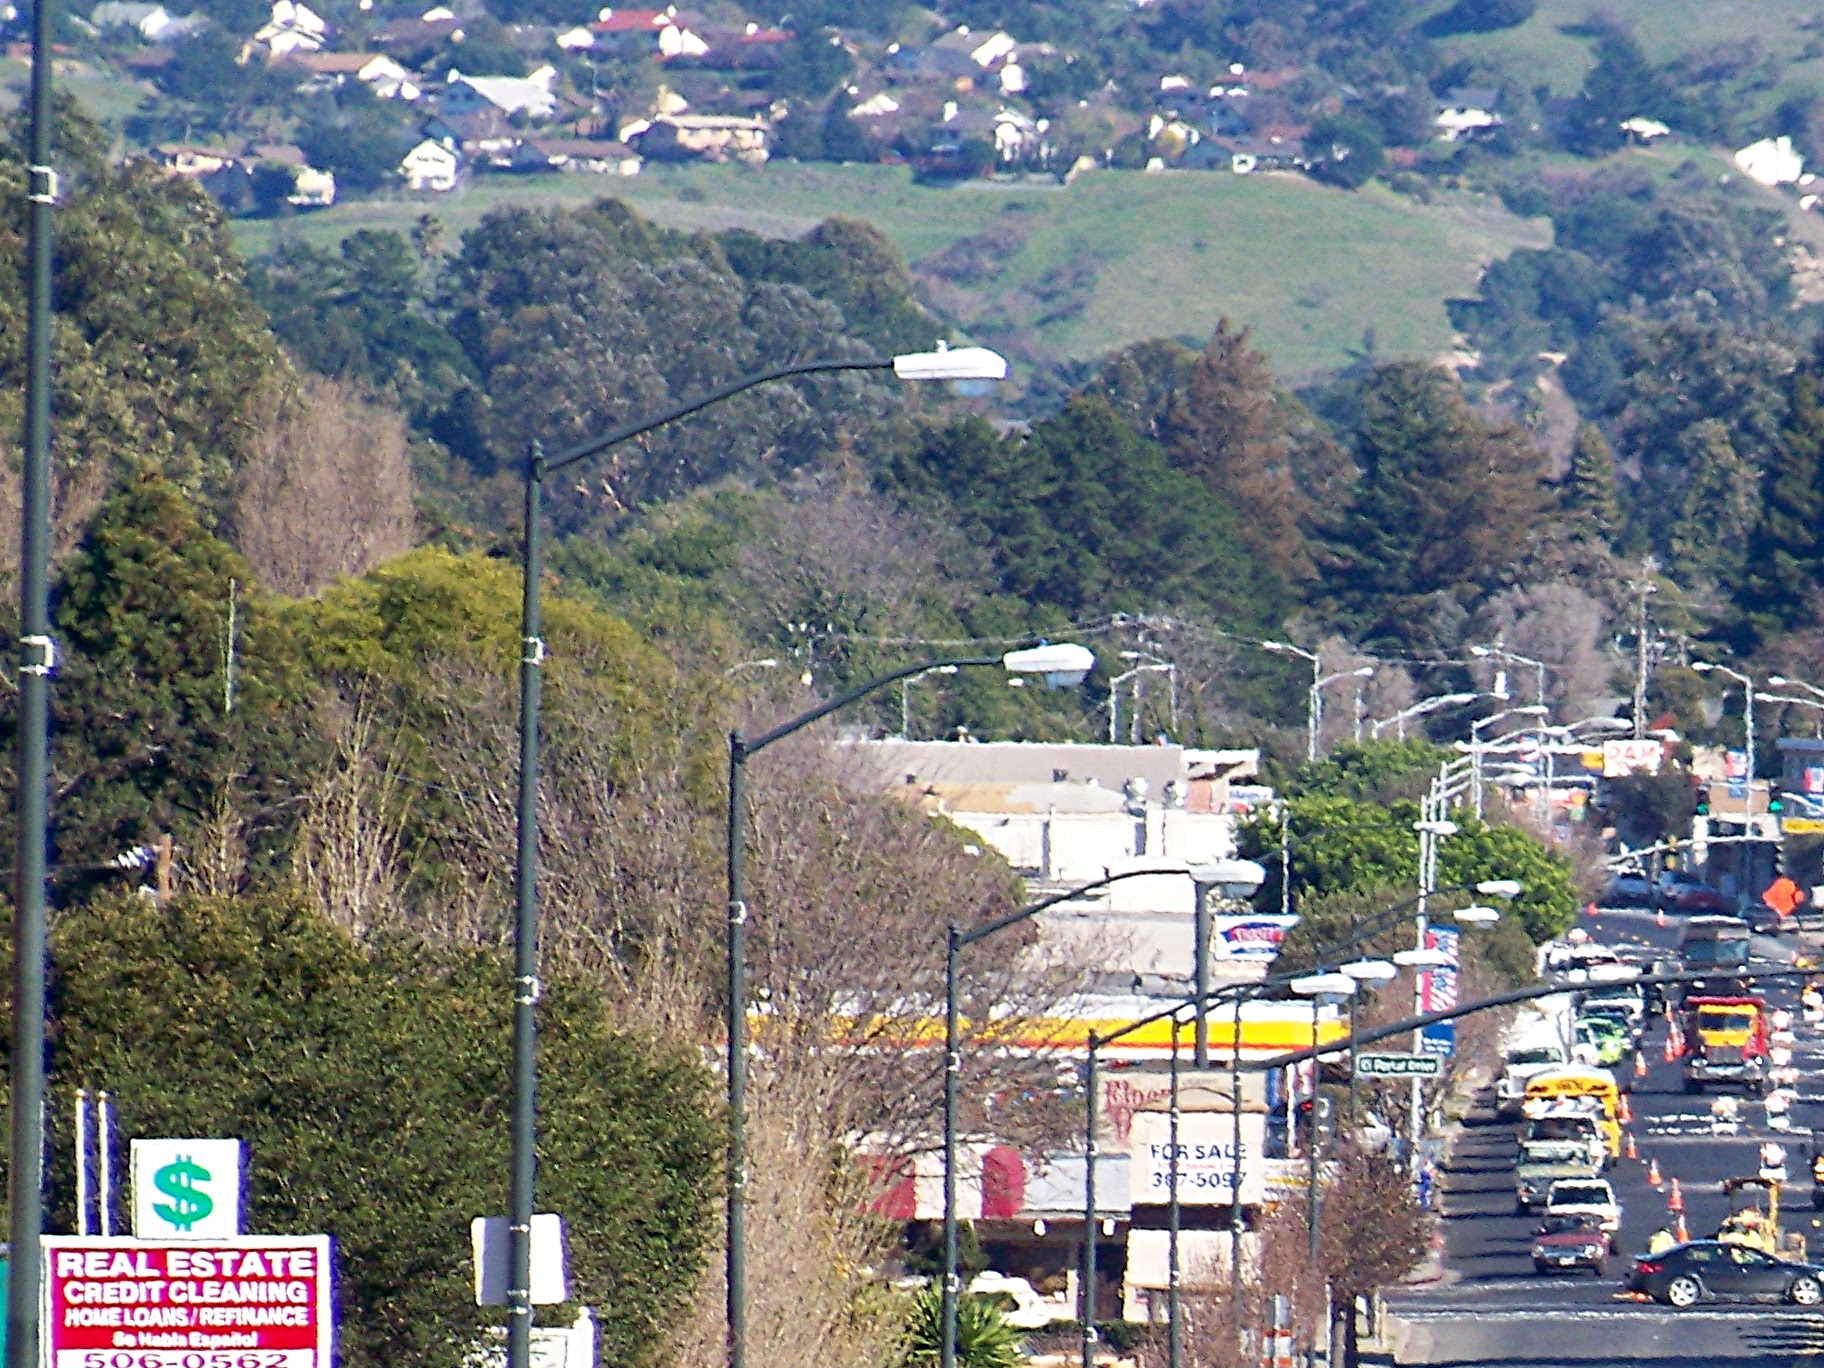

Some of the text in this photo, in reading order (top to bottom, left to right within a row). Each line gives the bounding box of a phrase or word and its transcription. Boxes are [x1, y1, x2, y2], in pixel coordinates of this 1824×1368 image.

[1150, 1144, 1247, 1160] FOR SALE
[152, 1154, 213, 1232] $
[57, 1251, 314, 1277] REAL ESTATE
[63, 1281, 308, 1304] CREDIT CLEANING
[64, 1307, 121, 1327] HOME
[112, 1331, 136, 1347] Se
[138, 1331, 188, 1347] Habla
